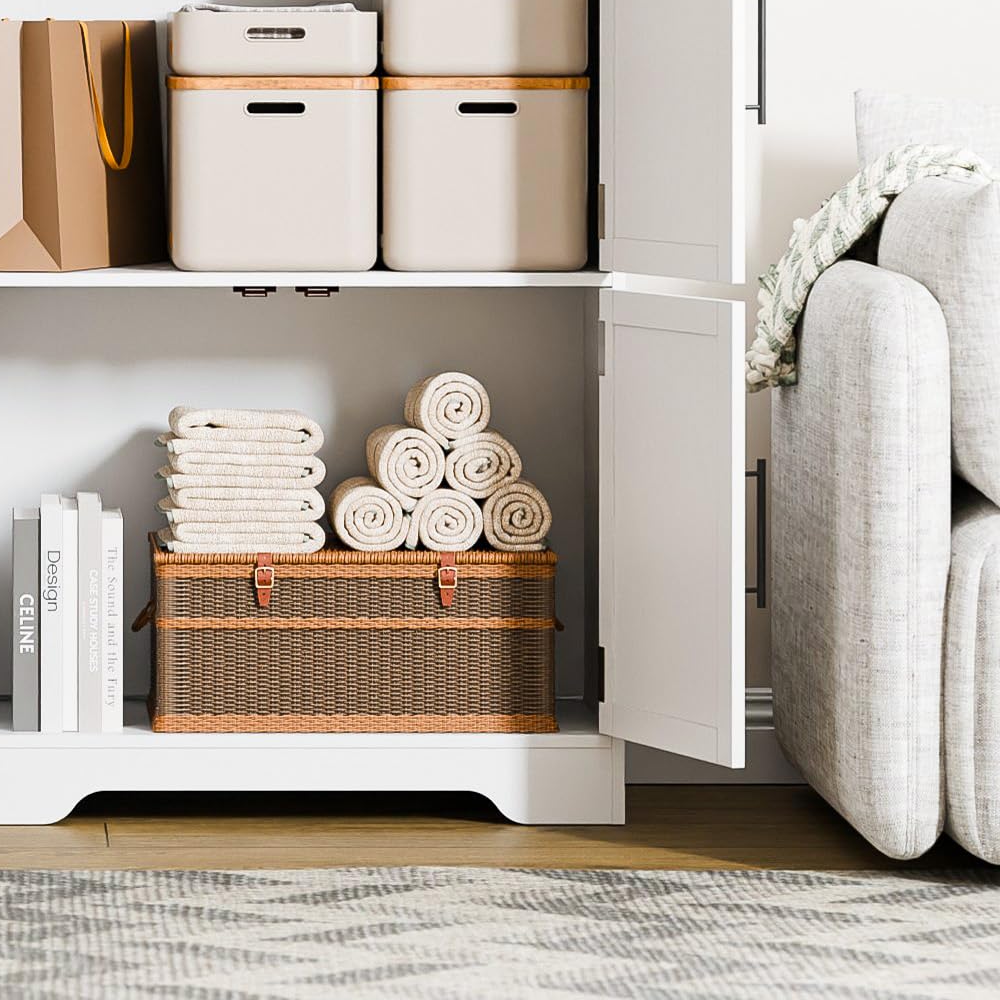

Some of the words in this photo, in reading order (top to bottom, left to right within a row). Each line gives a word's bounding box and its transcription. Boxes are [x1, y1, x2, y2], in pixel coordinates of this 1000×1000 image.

[107, 546, 118, 570] The
[43, 550, 61, 612] Design
[89, 569, 99, 596] CASE
[107, 576, 118, 617] Sound
[19, 593, 35, 654] CELINE
[89, 598, 99, 631] STUDY
[107, 622, 118, 646] and
[89, 632, 99, 672] HOUSES
[107, 652, 118, 672] the
[105, 678, 118, 707] Fury
